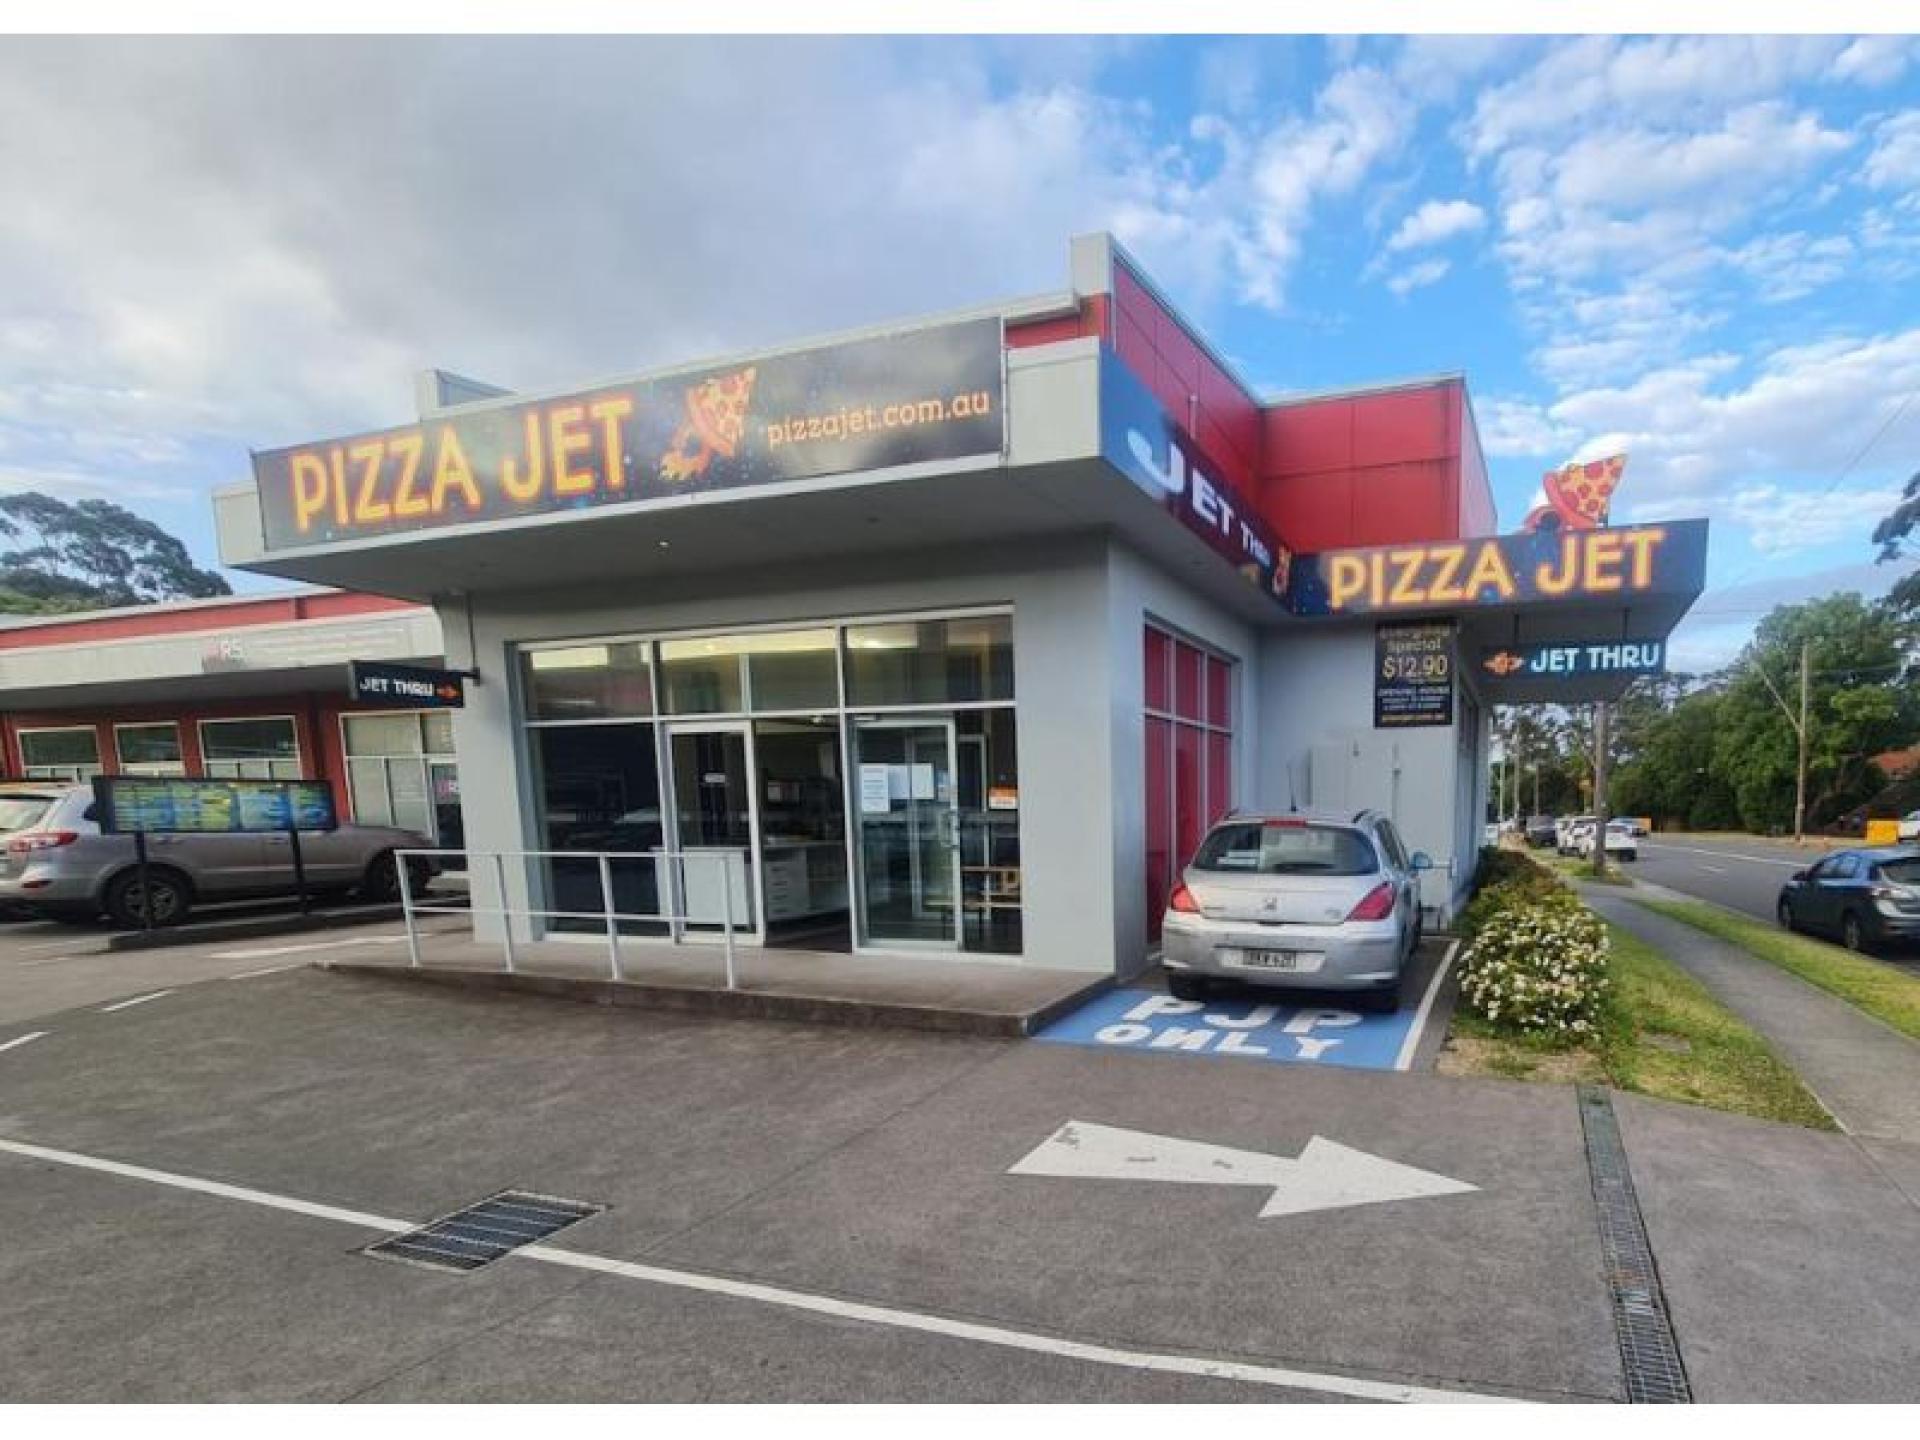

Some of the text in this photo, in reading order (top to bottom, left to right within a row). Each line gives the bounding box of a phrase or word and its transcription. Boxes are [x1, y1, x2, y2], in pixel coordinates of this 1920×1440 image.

[767, 391, 990, 450] pizzajet.com.au
[291, 393, 634, 535] PIZZA JET
[1127, 429, 1234, 535] JET
[1329, 528, 1665, 607] PIZZA JET
[1383, 654, 1448, 680] $12.90
[1530, 643, 1659, 673] JET THRU
[360, 677, 388, 693] JET
[1122, 995, 1363, 1034] PJP
[1094, 1024, 1343, 1059] ONLY
